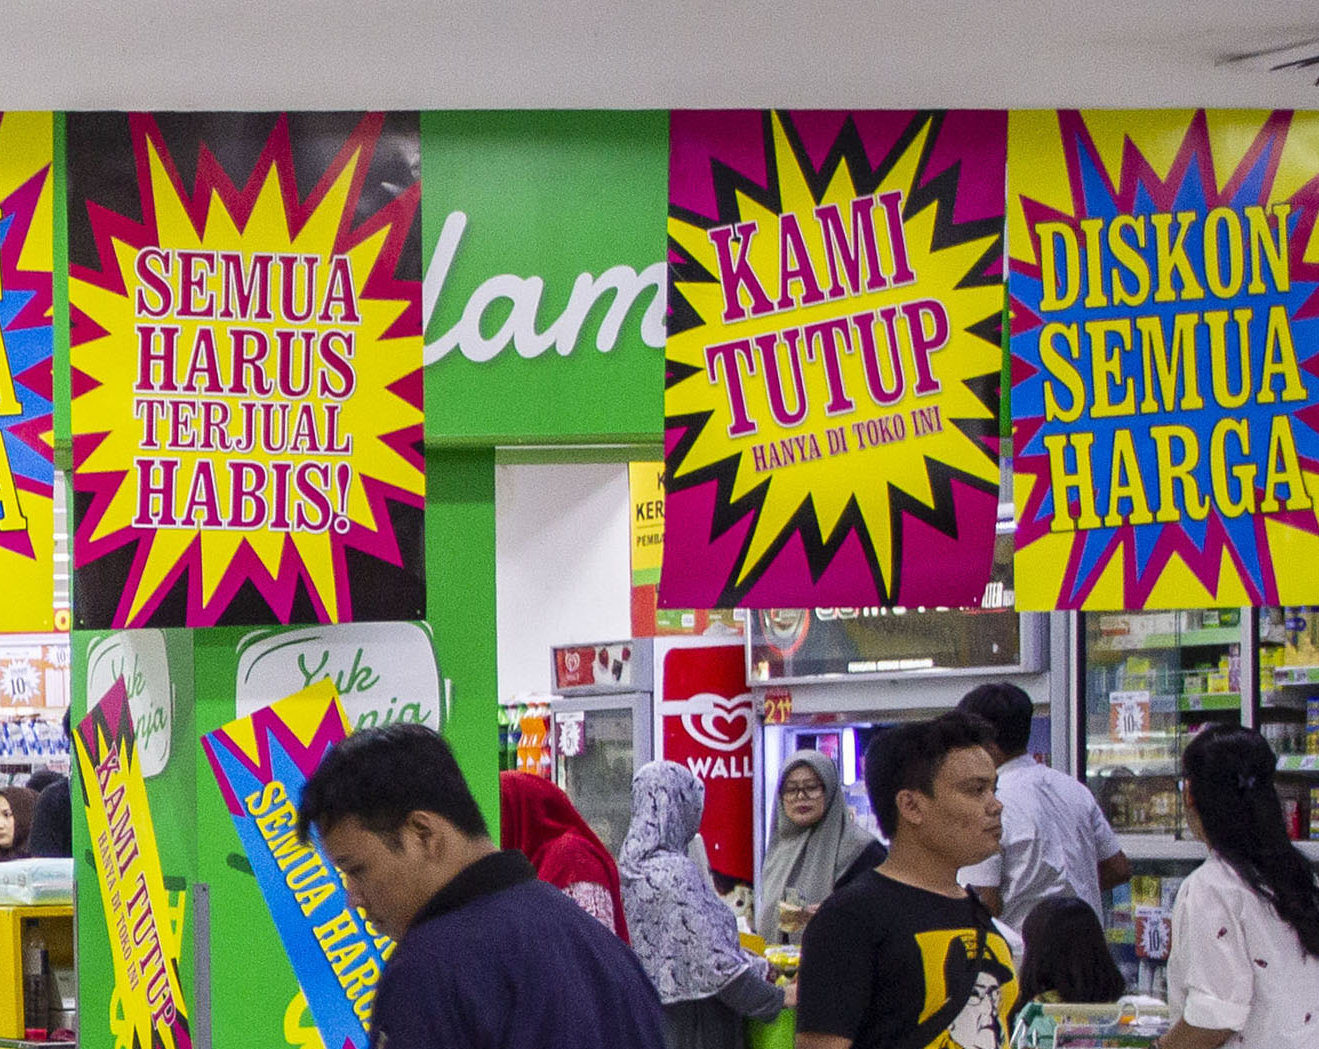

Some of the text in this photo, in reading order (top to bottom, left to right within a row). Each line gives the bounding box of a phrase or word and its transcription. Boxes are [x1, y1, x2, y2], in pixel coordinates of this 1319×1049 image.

[133, 246, 361, 326] SEMUA
[705, 189, 917, 324] KAMI
[1034, 201, 1292, 313] DISKON
[133, 325, 357, 401] HARUS
[703, 298, 952, 440] TUTUP
[1038, 303, 1309, 425] SEMUA
[133, 397, 354, 457] TERJUAL
[750, 404, 945, 475] HANYA DI TOKO INI
[1042, 413, 1314, 534] HARGA
[132, 456, 352, 535] HABIS!
[94, 741, 177, 1030] KAMI TUTUP
[244, 780, 337, 918] SEMUA
